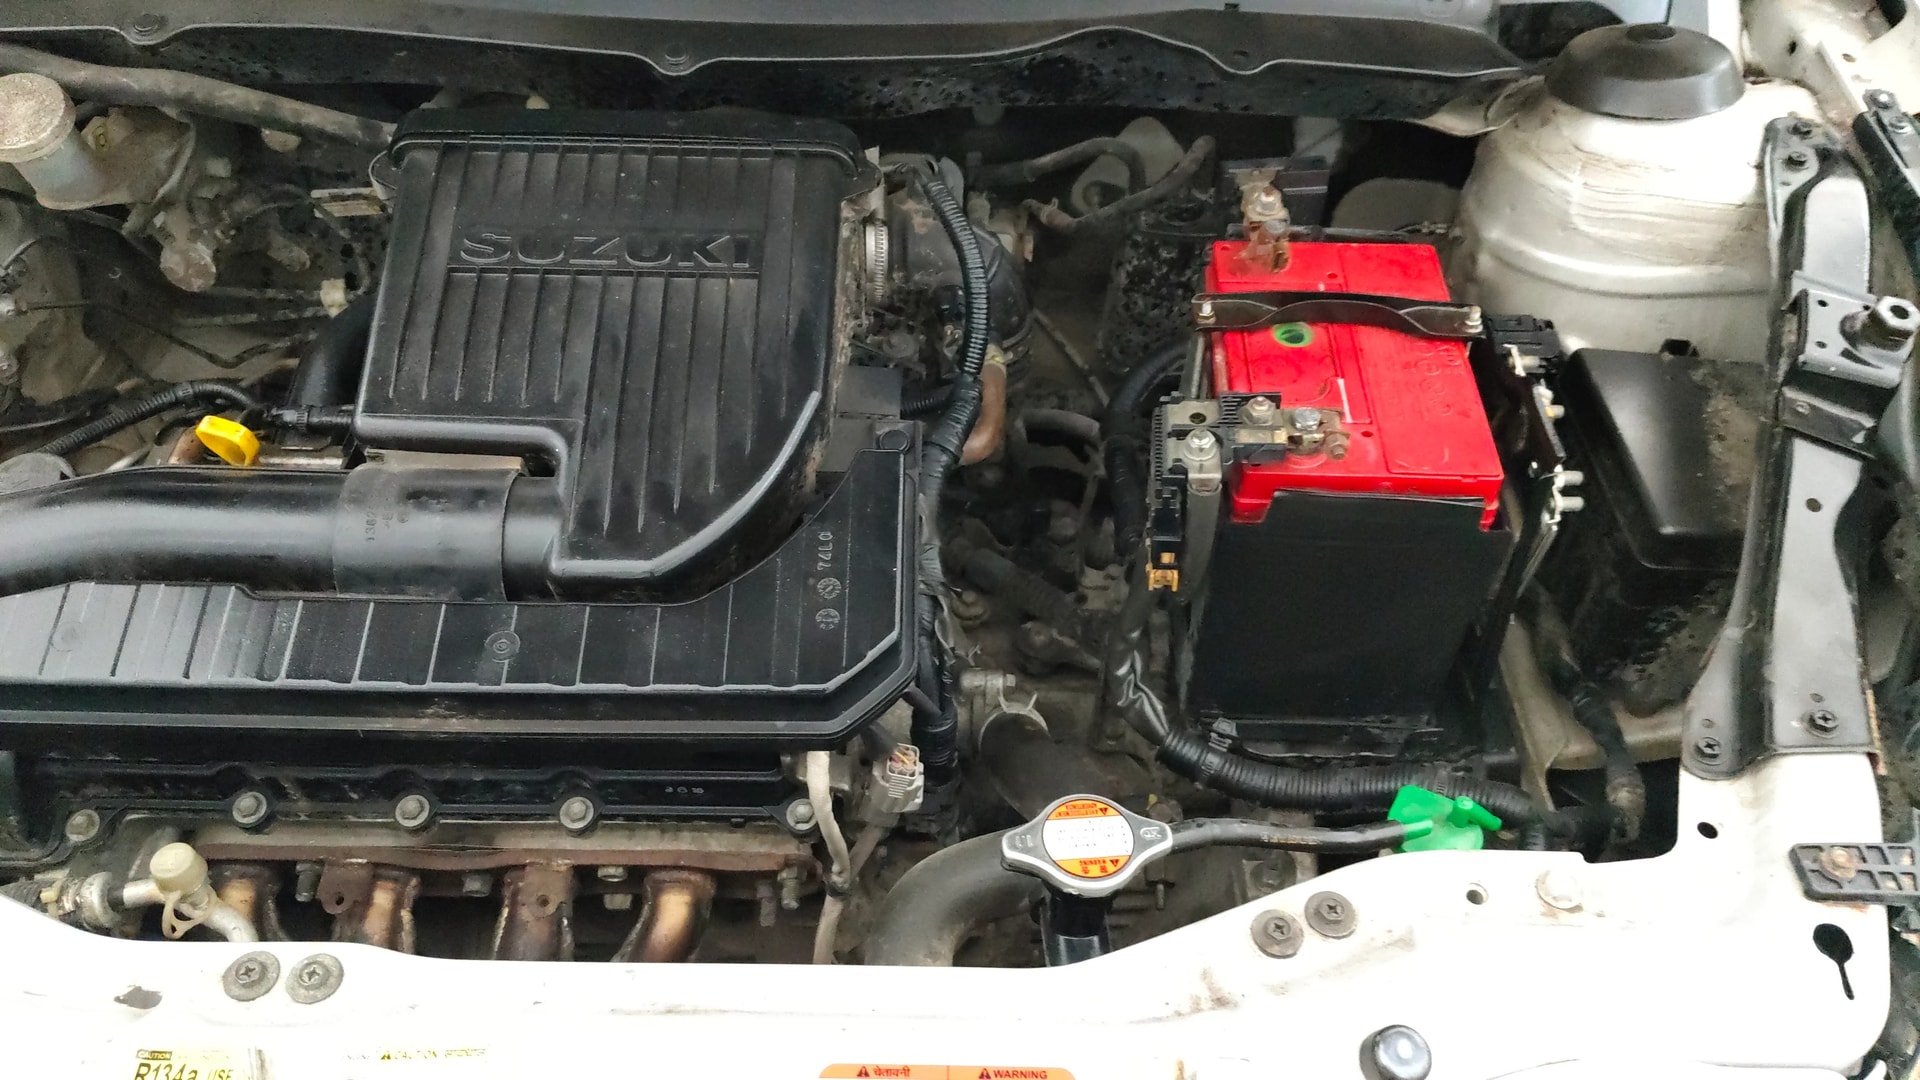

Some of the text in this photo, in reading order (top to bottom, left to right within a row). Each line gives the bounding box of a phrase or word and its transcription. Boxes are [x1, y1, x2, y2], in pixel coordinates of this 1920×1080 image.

[460, 233, 749, 267] SUZUKI
[137, 1050, 171, 1060] CAUTION
[873, 1065, 911, 1078] चेतावनी
[993, 1069, 1048, 1080] WARNING
